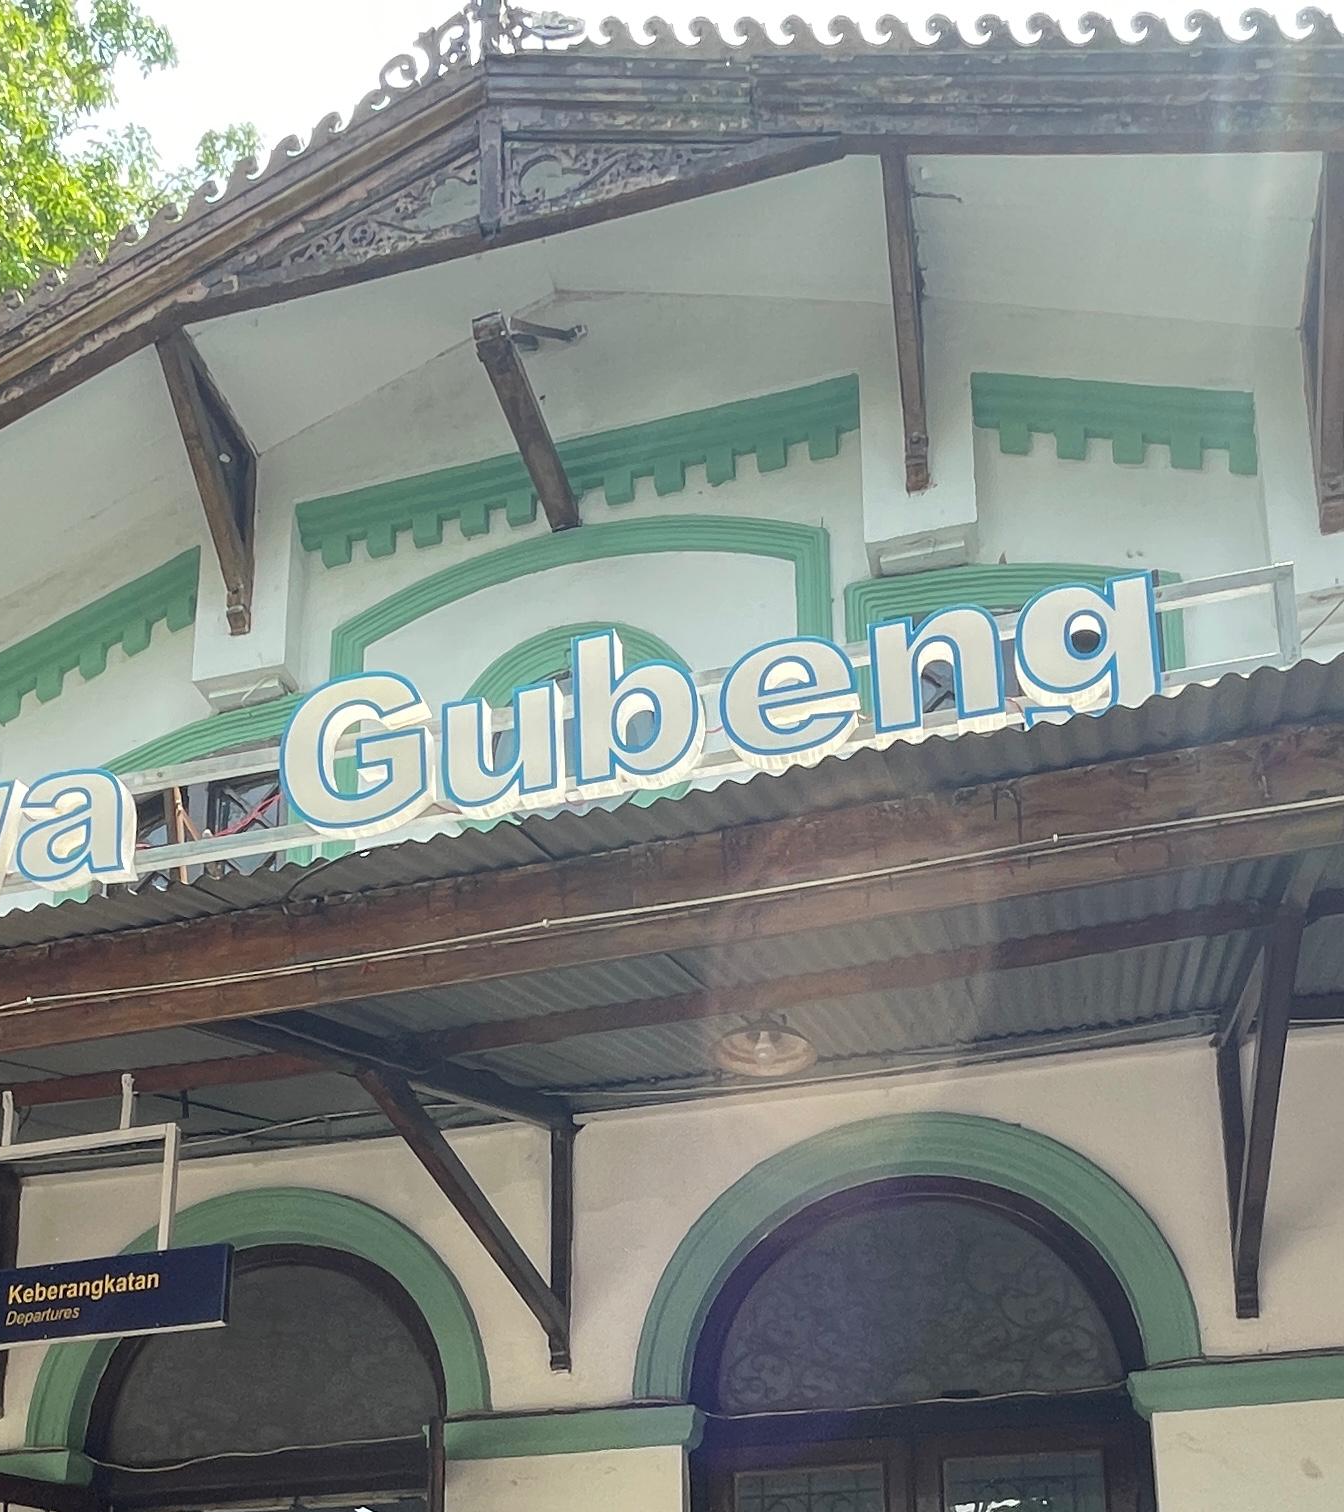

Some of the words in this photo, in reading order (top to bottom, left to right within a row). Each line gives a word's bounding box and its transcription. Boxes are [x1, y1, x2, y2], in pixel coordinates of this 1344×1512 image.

[279, 569, 1162, 841] Gubeng
[7, 1272, 160, 1304] Keberangkatan
[5, 1307, 81, 1326] Departures
